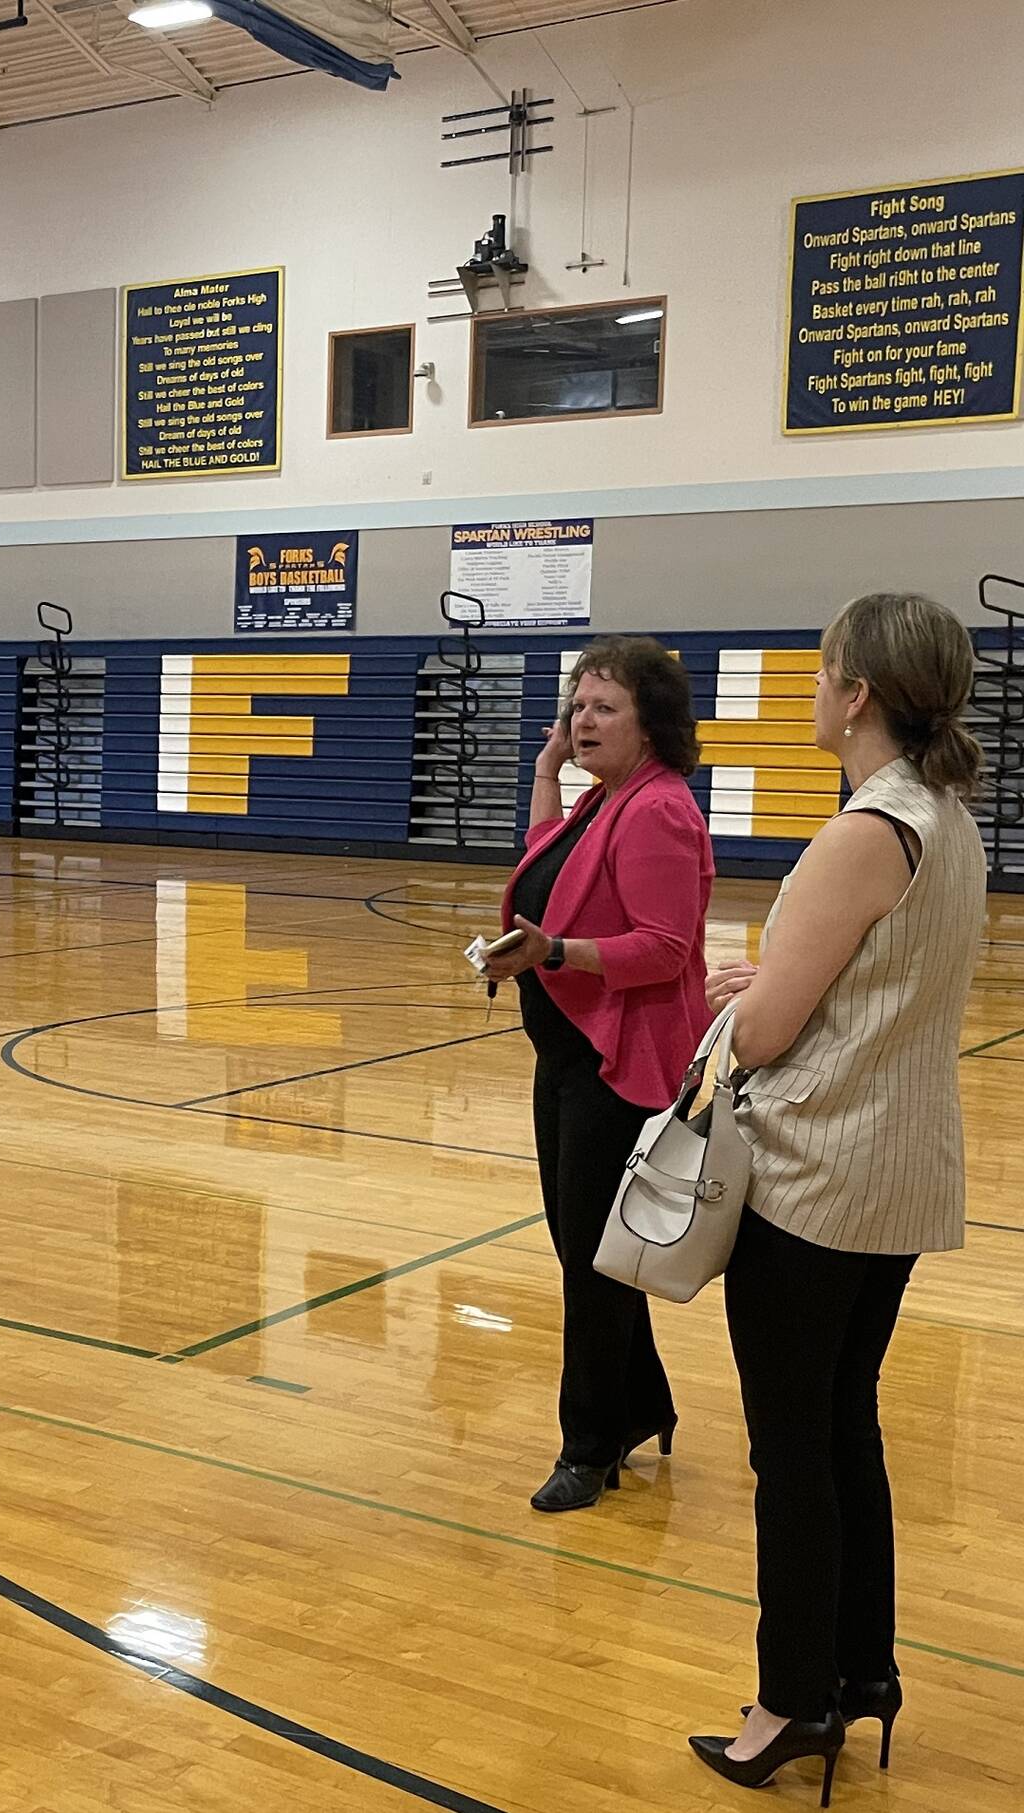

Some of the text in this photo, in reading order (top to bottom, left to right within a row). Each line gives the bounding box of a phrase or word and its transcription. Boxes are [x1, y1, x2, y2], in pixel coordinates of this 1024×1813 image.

[870, 195, 944, 218] Fight Song
[803, 211, 1015, 248] Onward Spartans, onward Spartans
[830, 238, 981, 272] Fight right down that line
[811, 261, 1000, 295] Pass the ball right to the center
[173, 284, 229, 298] Alma Mater
[154, 306, 162, 314] to
[197, 298, 220, 309] noble
[222, 296, 245, 307] Forks
[247, 293, 266, 305] High
[812, 285, 996, 319] Basket every time rah, rah, rah
[169, 316, 190, 328] Loyal
[205, 313, 219, 322] will
[221, 312, 232, 321] be
[798, 311, 1008, 343] Onward Spartans, onward Spartans
[154, 334, 173, 343] have
[175, 328, 204, 343] passed
[206, 327, 220, 337] but
[221, 325, 236, 336] still
[252, 322, 272, 333] cling
[163, 340, 238, 356] To many memories
[833, 340, 966, 368] Fight on for your fame
[138, 362, 153, 372] Still
[168, 360, 186, 370] sing
[188, 358, 200, 367] the
[202, 355, 216, 366] old
[217, 355, 243, 365] songs
[244, 352, 263, 361] over
[156, 366, 244, 384] Dreams of days of old
[808, 361, 992, 394] Fight Spartans fight, fight, fight
[138, 390, 153, 400] Still
[168, 388, 190, 397] cheer
[192, 386, 205, 395] the
[207, 384, 225, 394] best
[227, 382, 236, 392] of
[237, 381, 264, 391] colors
[172, 402, 185, 411] the
[187, 400, 206, 410] Blue
[207, 398, 223, 408] and
[224, 396, 244, 407] Gold
[831, 388, 964, 413] To win the game HEY!
[137, 418, 152, 428] Still
[167, 416, 185, 427] sing
[186, 415, 200, 424] the
[201, 412, 214, 422] old
[216, 412, 242, 422] songs
[244, 410, 264, 419] over
[159, 425, 241, 440] Dream of days of old
[138, 446, 153, 455] Still
[167, 444, 190, 453] cheer
[191, 443, 205, 452] the
[206, 441, 225, 450] best
[226, 439, 236, 449] of
[237, 438, 263, 448] colors
[141, 451, 259, 468] HAIL THE BLUE AND GOLD!
[454, 525, 591, 544] SPARTAN WRESTLING
[280, 548, 313, 564] FORKS
[249, 568, 345, 586] BOYS BASKETBALL
[157, 654, 351, 815] F
